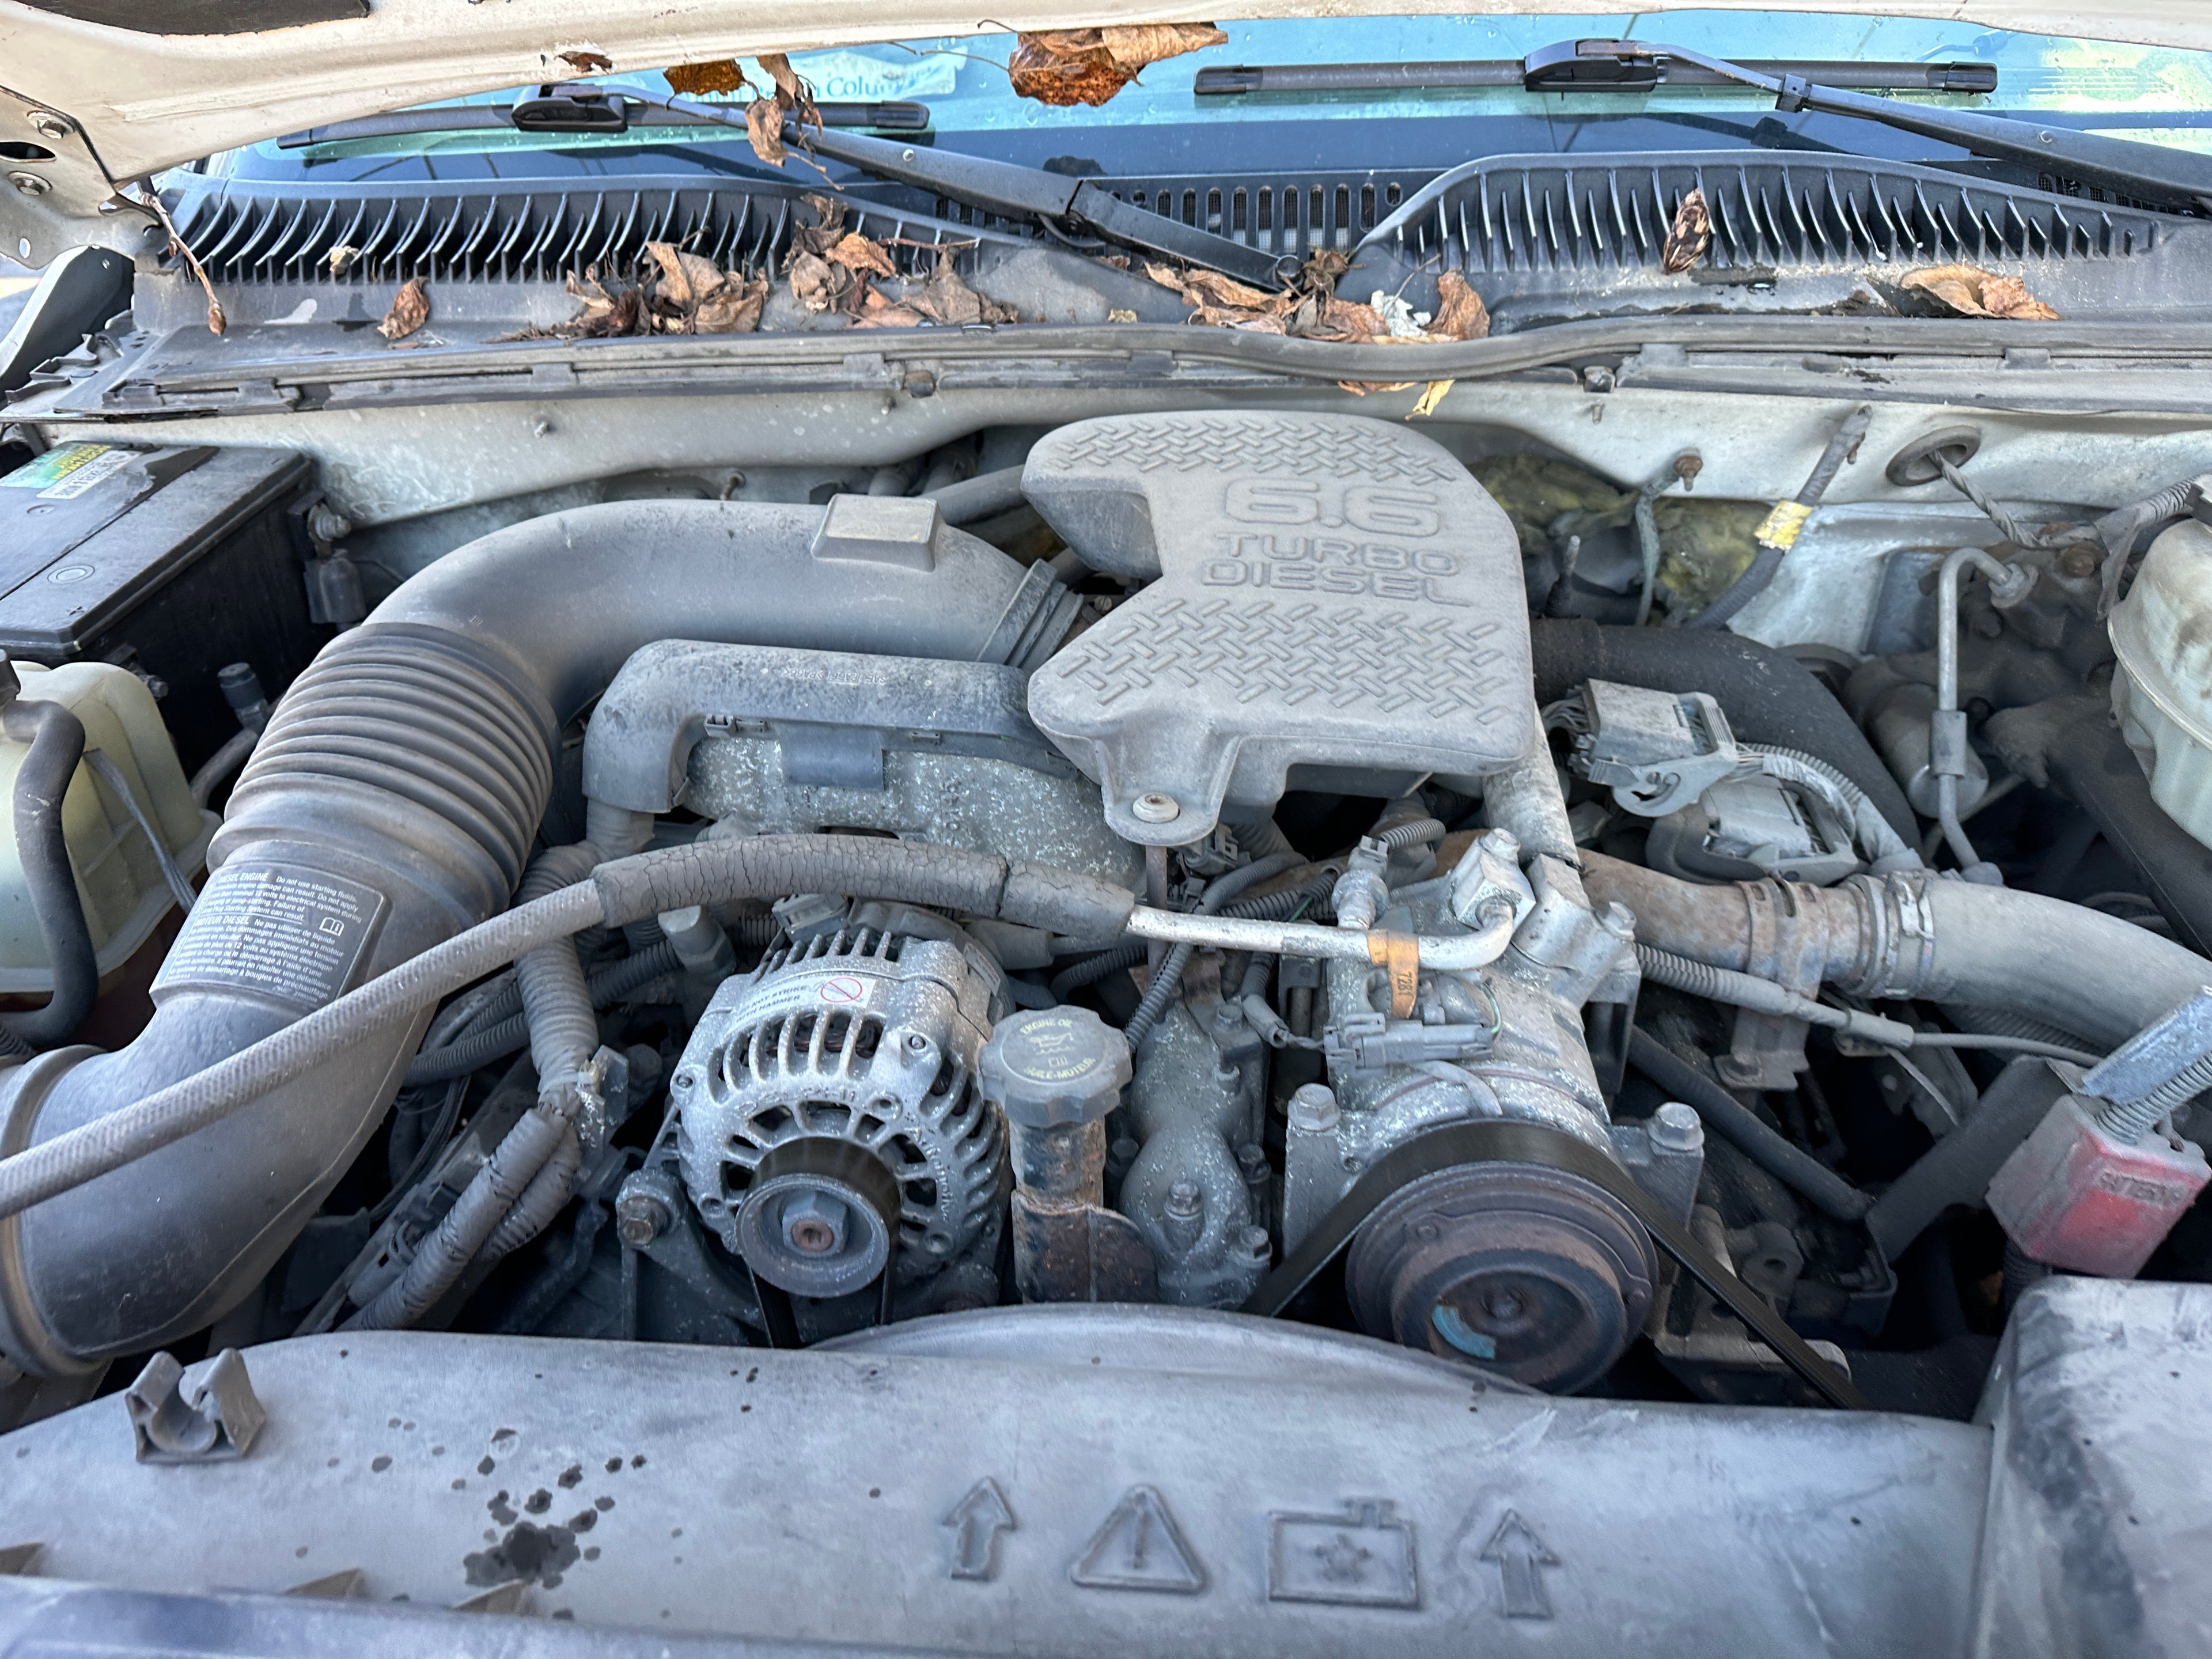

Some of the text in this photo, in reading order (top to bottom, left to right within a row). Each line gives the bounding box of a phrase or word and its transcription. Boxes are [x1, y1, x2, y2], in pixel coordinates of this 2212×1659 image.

[1225, 476, 1440, 538] 6.6
[1214, 532, 1460, 577] TURBO
[1200, 559, 1473, 608] DIESEL
[240, 873, 269, 881] ENGINE
[312, 884, 336, 896] starting
[338, 891, 357, 903] fluids.
[257, 883, 281, 892] damage
[295, 889, 315, 898] result.
[317, 893, 327, 902] Do
[328, 897, 339, 906] not
[340, 902, 358, 912] apply
[247, 905, 270, 915] System
[284, 912, 304, 921] result.
[274, 900, 296, 911] Failure
[286, 895, 316, 907] electrical
[317, 903, 340, 915] system
[342, 911, 362, 923] during
[196, 915, 223, 926] MOTEUR
[223, 915, 249, 925] DIESEL
[254, 918, 264, 926] Ne
[278, 924, 302, 934] utiliser
[302, 930, 311, 938] de
[312, 932, 335, 945] liquide
[237, 926, 272, 937] dommages
[274, 931, 309, 946] immédiats
[320, 945, 344, 958] moteur
[233, 941, 242, 949] 12
[243, 944, 259, 952] volts
[269, 949, 298, 961] système
[299, 956, 333, 972] électrique
[243, 934, 253, 942] Ne
[267, 940, 299, 952] appliquer
[300, 948, 313, 956] une
[315, 950, 339, 965] tension
[221, 959, 247, 968] pourrait
[256, 964, 282, 974] résulter
[283, 970, 296, 979] une
[297, 974, 331, 990] défaillance
[240, 952, 275, 964] démarrage
[282, 959, 301, 971] l'aide
[302, 967, 322, 978] d'une
[205, 965, 238, 976] démarrage
[245, 969, 272, 981] bougies
[283, 979, 329, 999] préchauffage.
[752, 995, 770, 1007] NOT
[772, 986, 806, 998] STRIKE
[759, 995, 800, 1011] HAMMER
[1020, 1018, 1055, 1035] ENGINE
